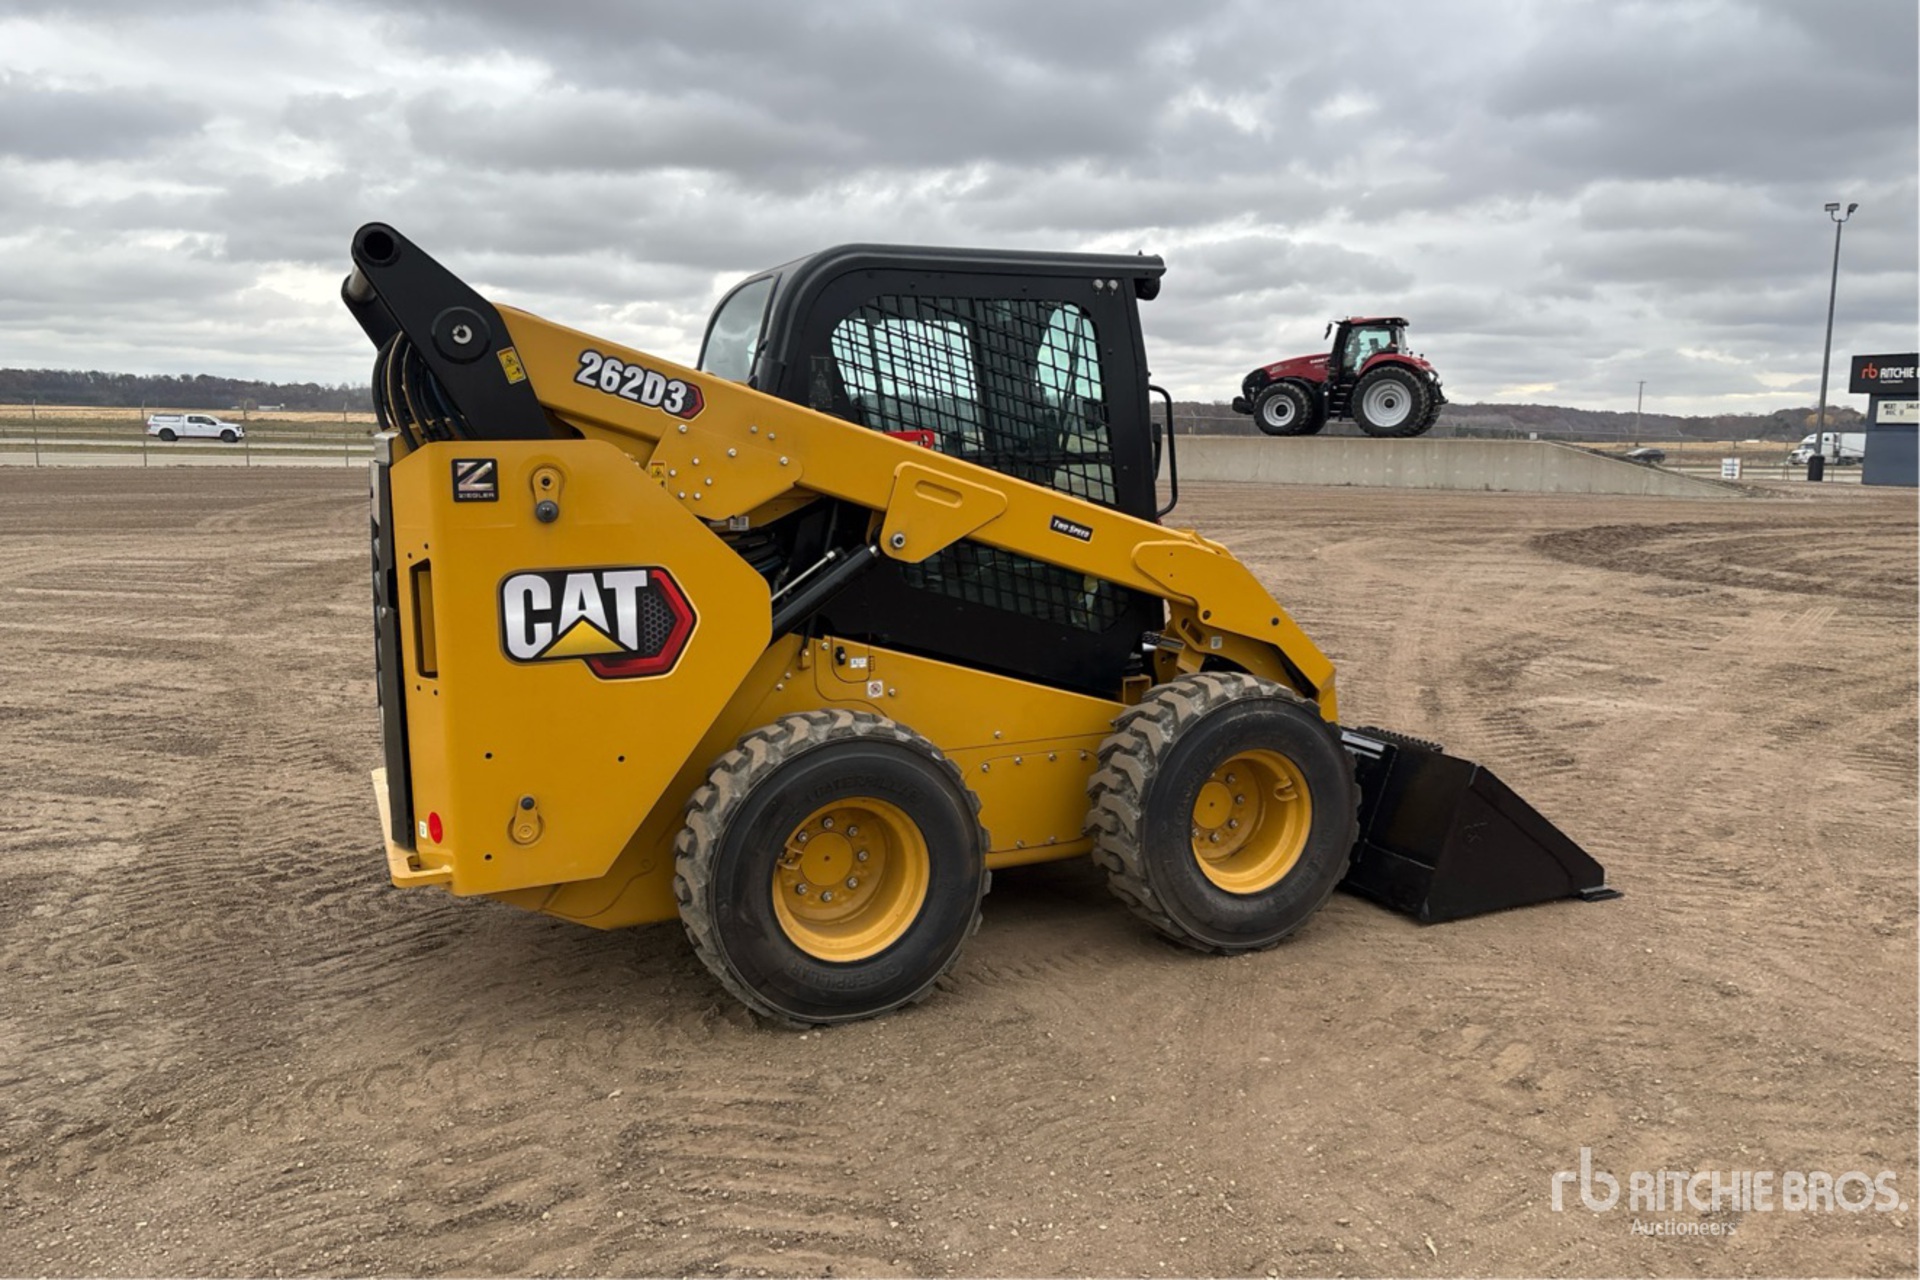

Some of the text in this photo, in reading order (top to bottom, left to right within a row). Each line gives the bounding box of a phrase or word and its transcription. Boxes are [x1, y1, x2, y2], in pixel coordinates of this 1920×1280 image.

[575, 350, 688, 415] 262D3
[1861, 362, 1878, 379] rb
[1880, 366, 1915, 378] RITCHIE
[503, 569, 648, 660] CAT
